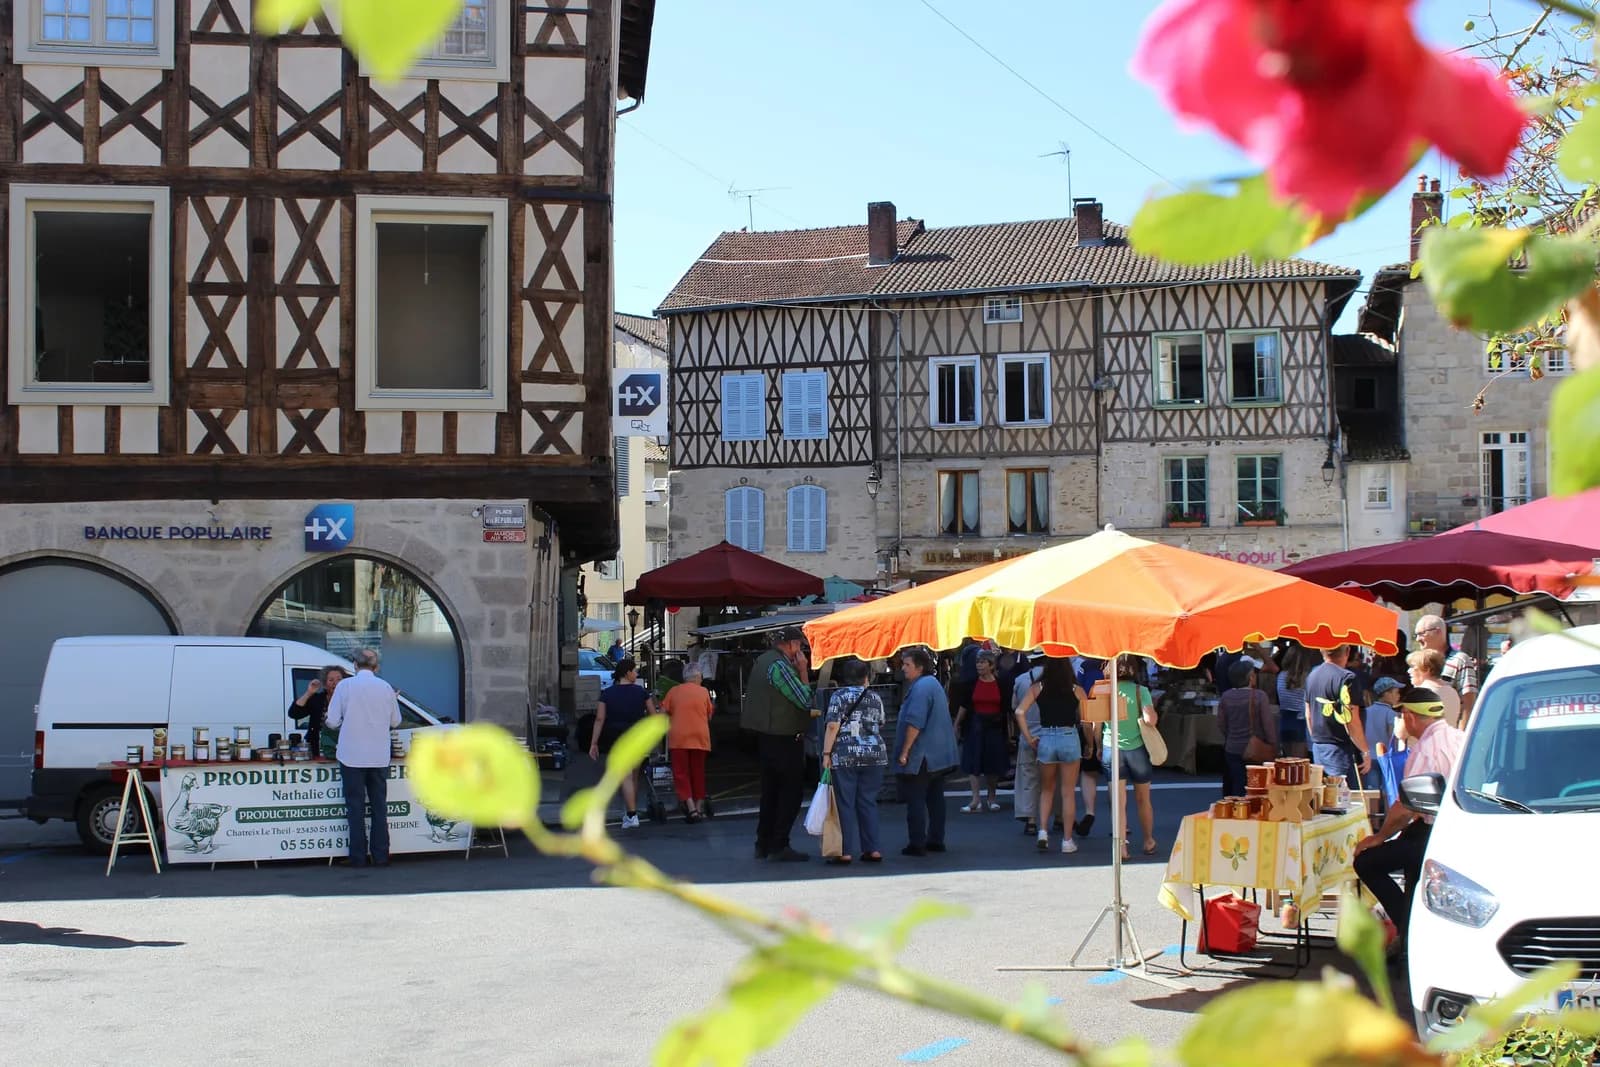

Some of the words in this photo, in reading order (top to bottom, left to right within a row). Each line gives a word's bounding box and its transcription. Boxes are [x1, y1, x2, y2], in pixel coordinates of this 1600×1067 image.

[84, 526, 162, 540] BANQUE
[169, 526, 273, 540] POPULAIRE
[1520, 694, 1600, 709] ATTENTIO
[203, 769, 312, 787] PRODUITS
[272, 788, 324, 801] Nathalie
[239, 808, 314, 821] PRODUCTRICE
[315, 808, 329, 817] DE
[387, 804, 408, 814] RAS
[226, 829, 260, 838] Chatreix
[261, 828, 270, 836] Le
[271, 827, 291, 836] Theil
[319, 825, 328, 834] St
[329, 824, 349, 833] MAR
[280, 840, 297, 851] 05
[299, 839, 315, 850] 55
[317, 838, 333, 849] 64
[335, 837, 350, 848] 81
